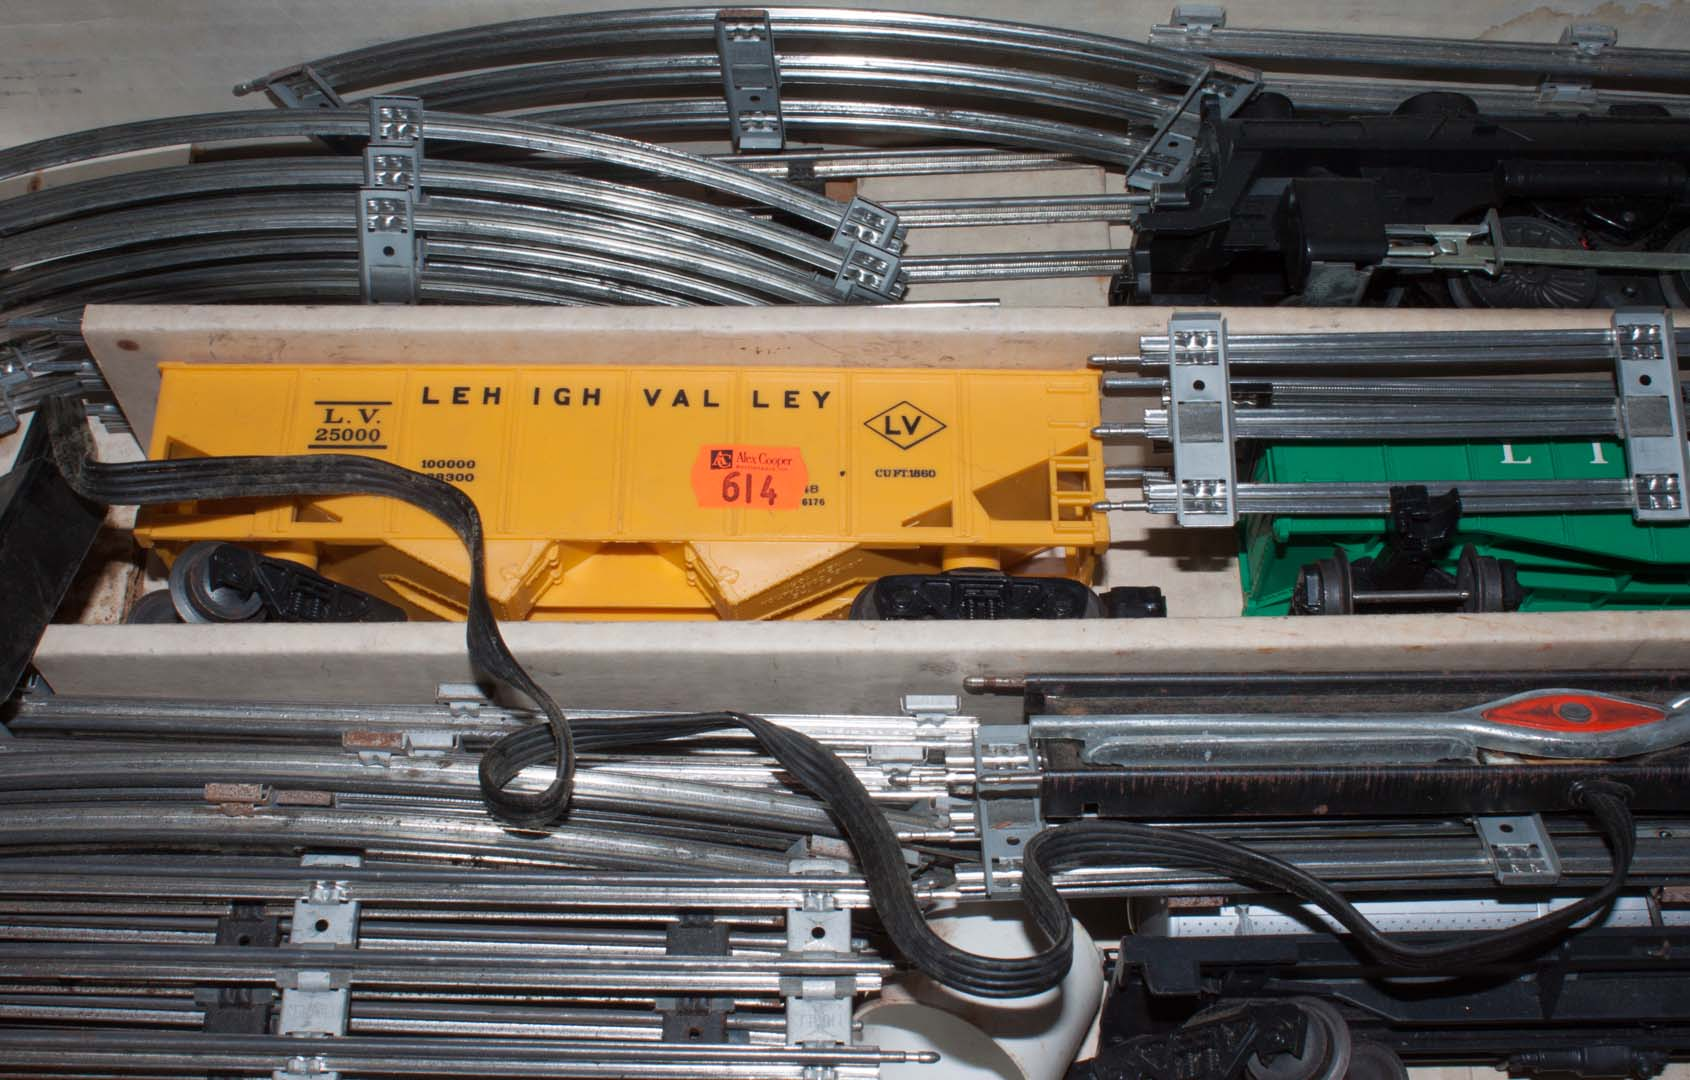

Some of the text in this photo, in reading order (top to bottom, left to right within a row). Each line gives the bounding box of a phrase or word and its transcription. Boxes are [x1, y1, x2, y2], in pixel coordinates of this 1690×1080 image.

[885, 415, 922, 435] LV
[314, 428, 381, 442] 25000
[421, 459, 476, 469] 100000
[736, 451, 793, 467] Alex Cooper
[722, 471, 777, 506] 614
